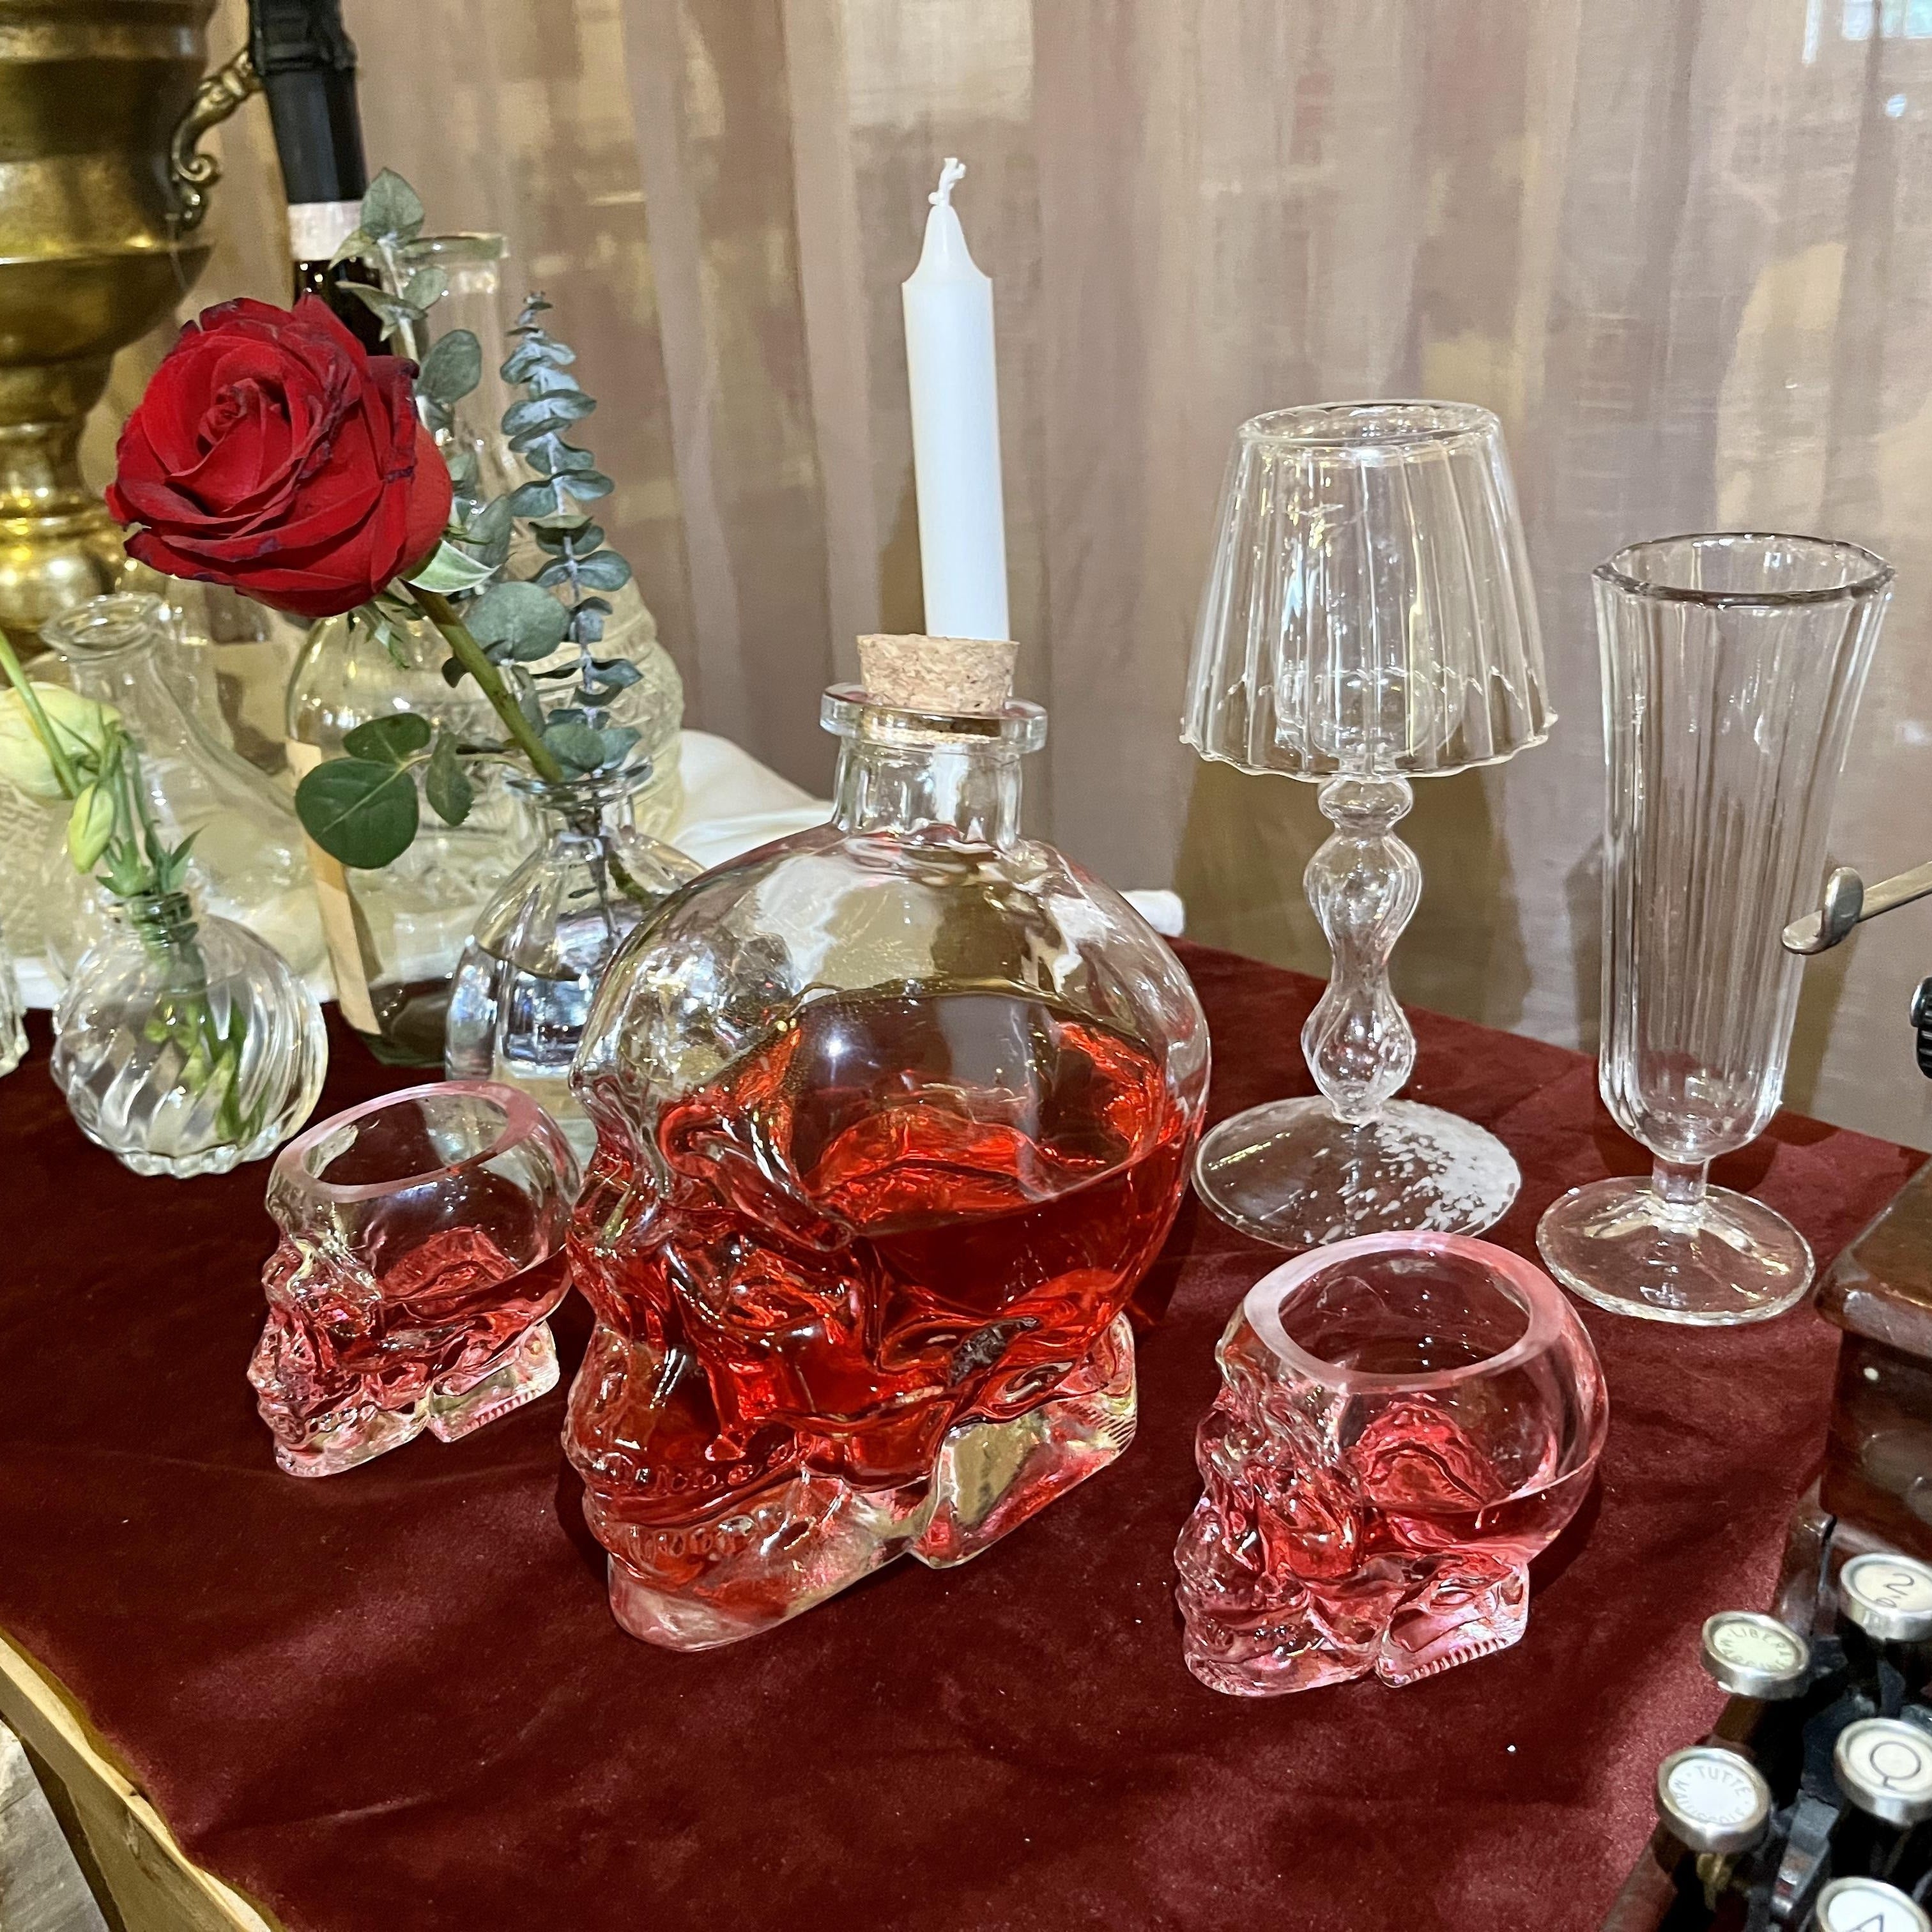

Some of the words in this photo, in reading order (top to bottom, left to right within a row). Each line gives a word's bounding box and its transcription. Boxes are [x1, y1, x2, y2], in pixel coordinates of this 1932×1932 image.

[1883, 1572, 1915, 1596] 2
[1694, 1765, 1752, 1797] TUTTE
[1869, 1740, 1922, 1791] Q
